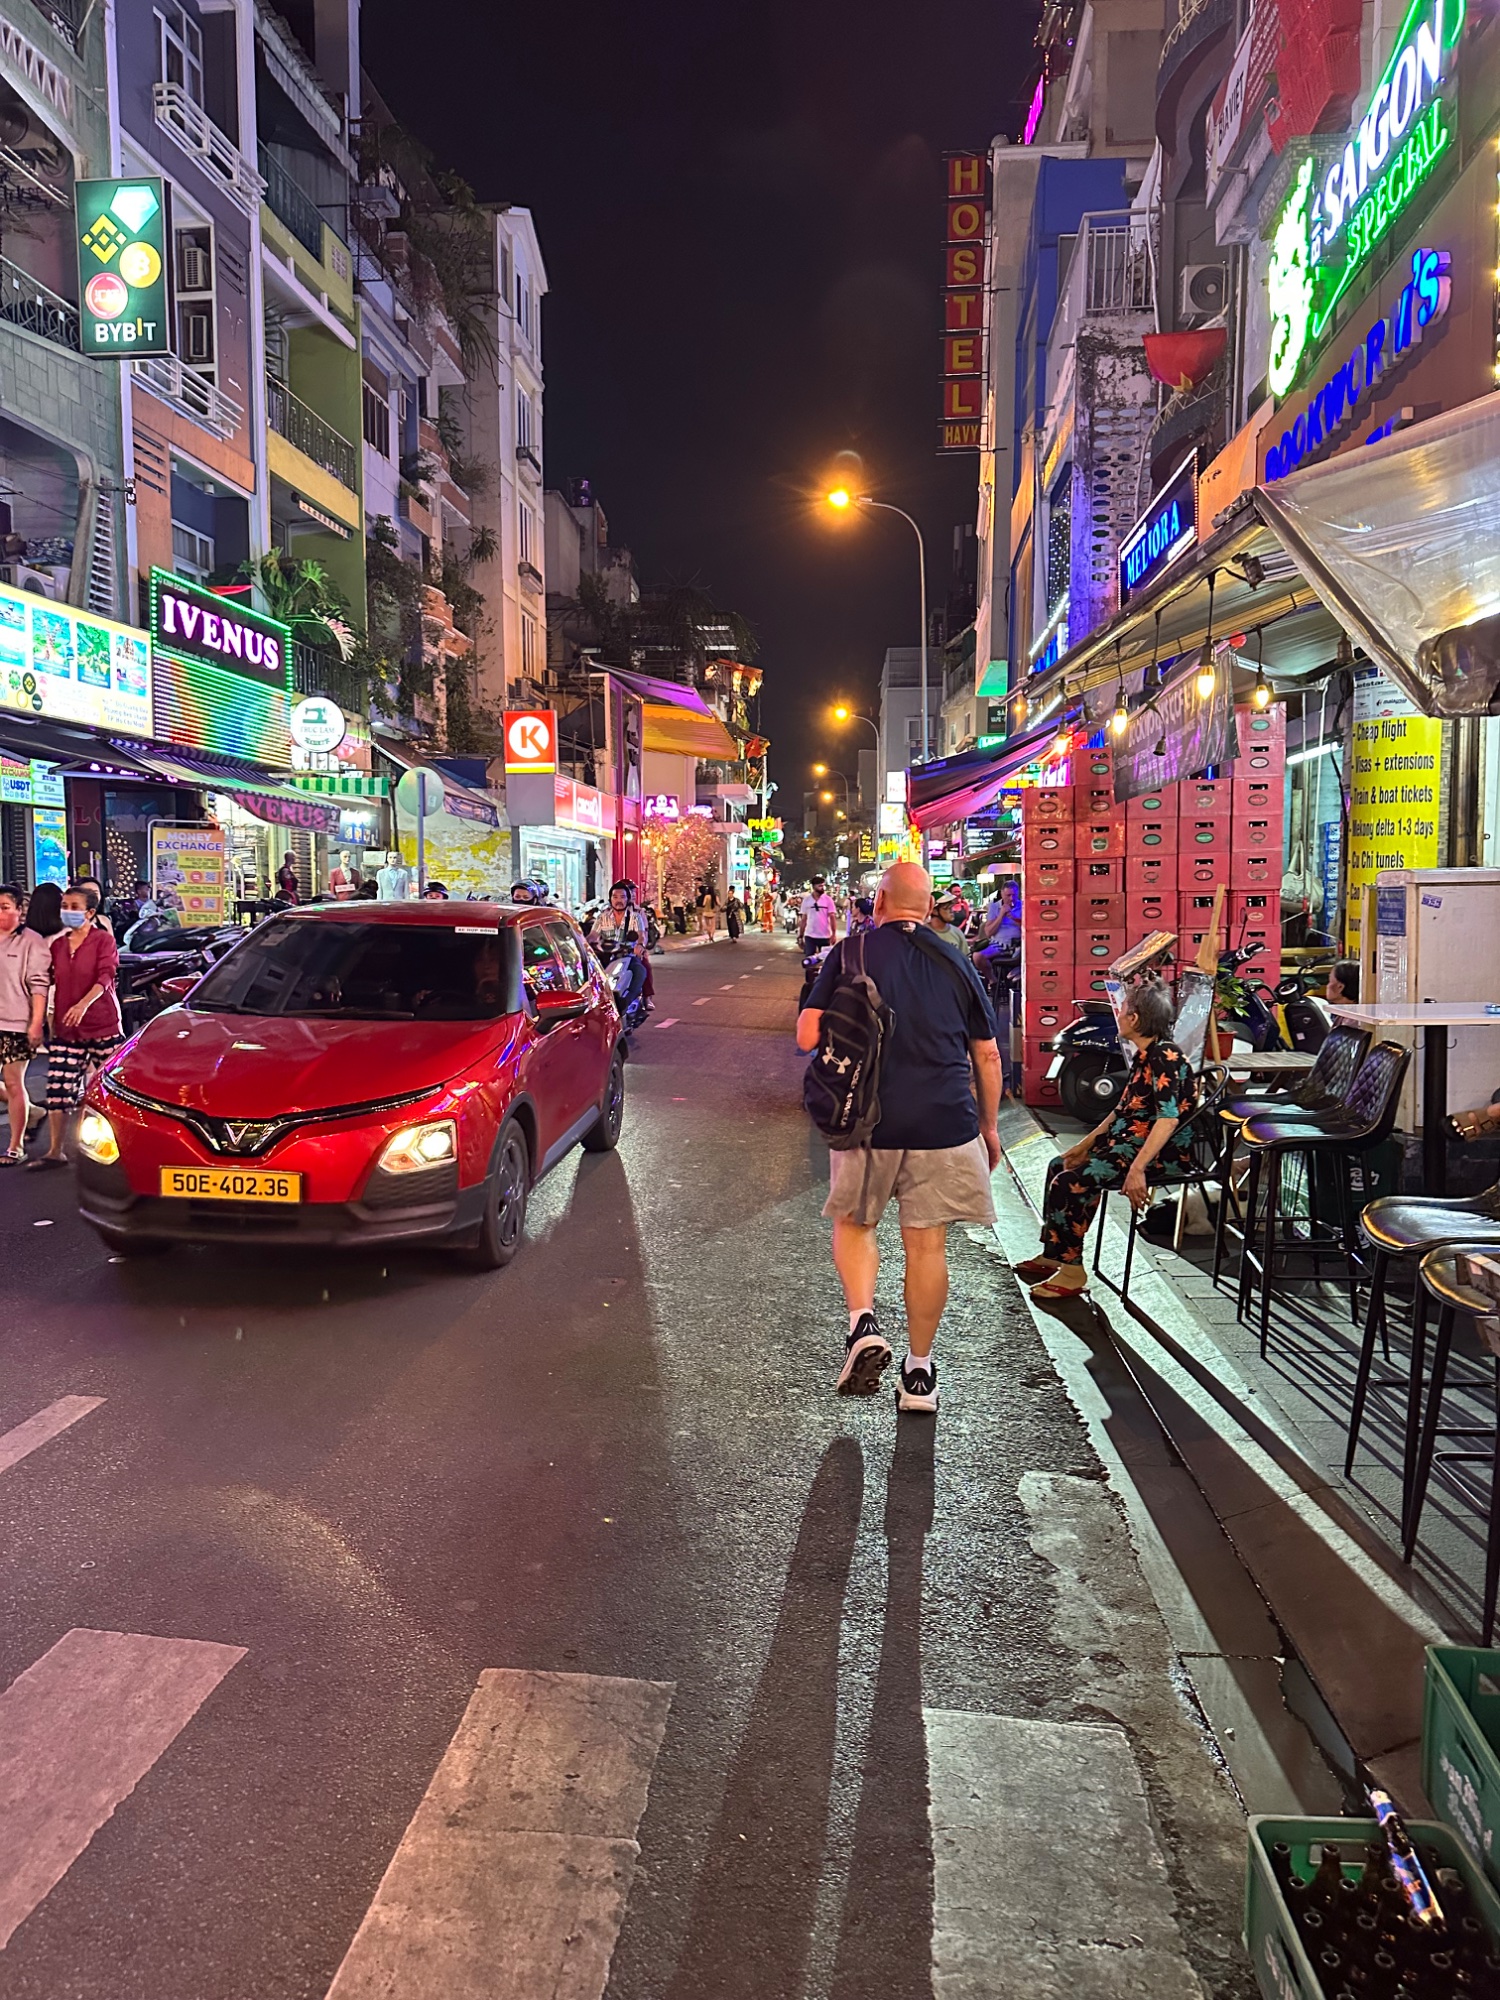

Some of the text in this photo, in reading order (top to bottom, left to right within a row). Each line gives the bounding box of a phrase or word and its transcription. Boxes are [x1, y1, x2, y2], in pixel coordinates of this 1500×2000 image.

[1325, 0, 1443, 246] SAIGON
[1347, 96, 1448, 269] SPECIAL
[952, 159, 980, 413] HOSTEL
[95, 317, 156, 343] BYBIT
[945, 424, 979, 445] HAVY
[1126, 500, 1180, 589] MELIORA
[162, 594, 279, 670] IVENUS
[520, 726, 542, 754] K
[1357, 719, 1407, 743] Cheap flight
[1355, 755, 1372, 773] Visas
[1384, 752, 1435, 771] extensions
[10, 779, 31, 792] USDT
[1353, 784, 1433, 805] Train & boat tickets
[166, 831, 212, 842] MONEY
[1352, 817, 1434, 840] Mekong delta 1-3 days
[156, 840, 222, 851] EXCHANGE
[1352, 850, 1405, 869] Cu Chi tunels
[173, 1173, 289, 1197] 50E-402.36
